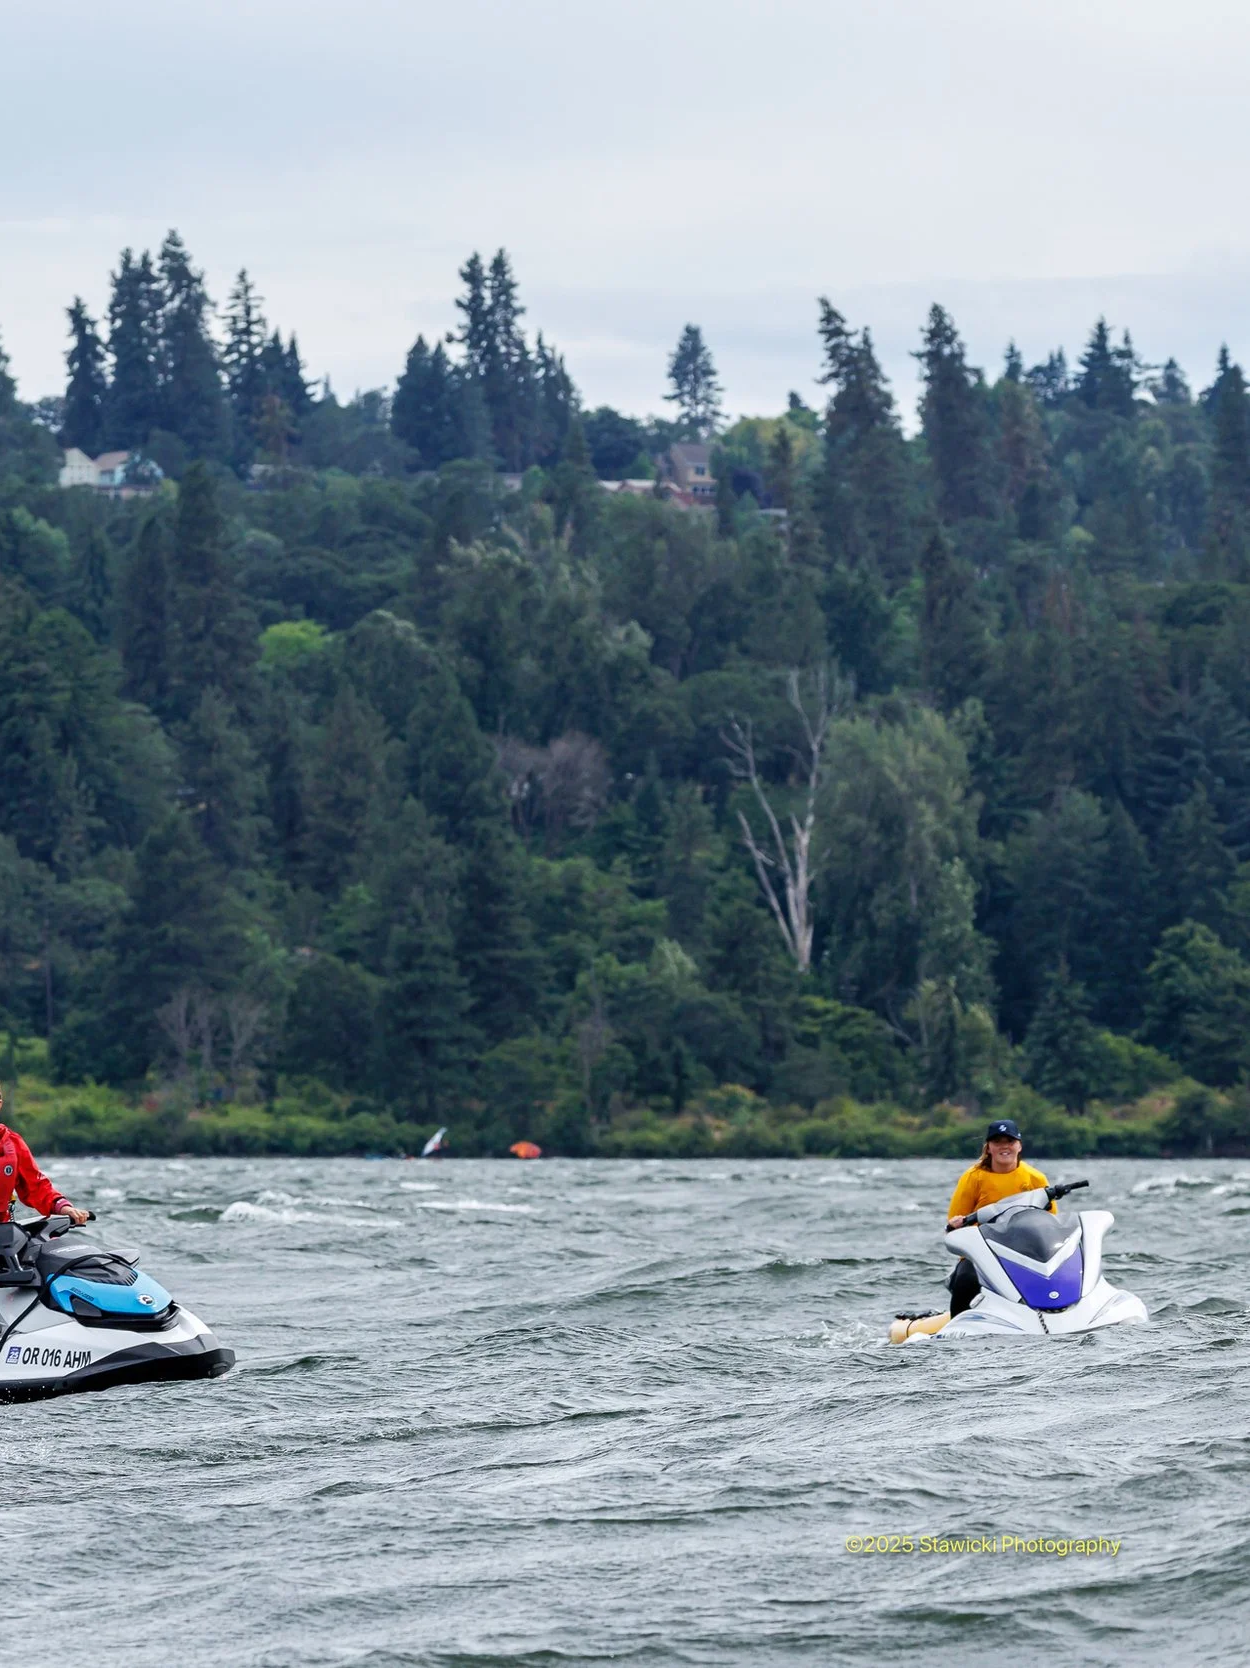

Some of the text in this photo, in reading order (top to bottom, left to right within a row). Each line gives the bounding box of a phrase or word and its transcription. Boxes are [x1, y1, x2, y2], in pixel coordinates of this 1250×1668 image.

[22, 1347, 92, 1368] OR 016 AHM
